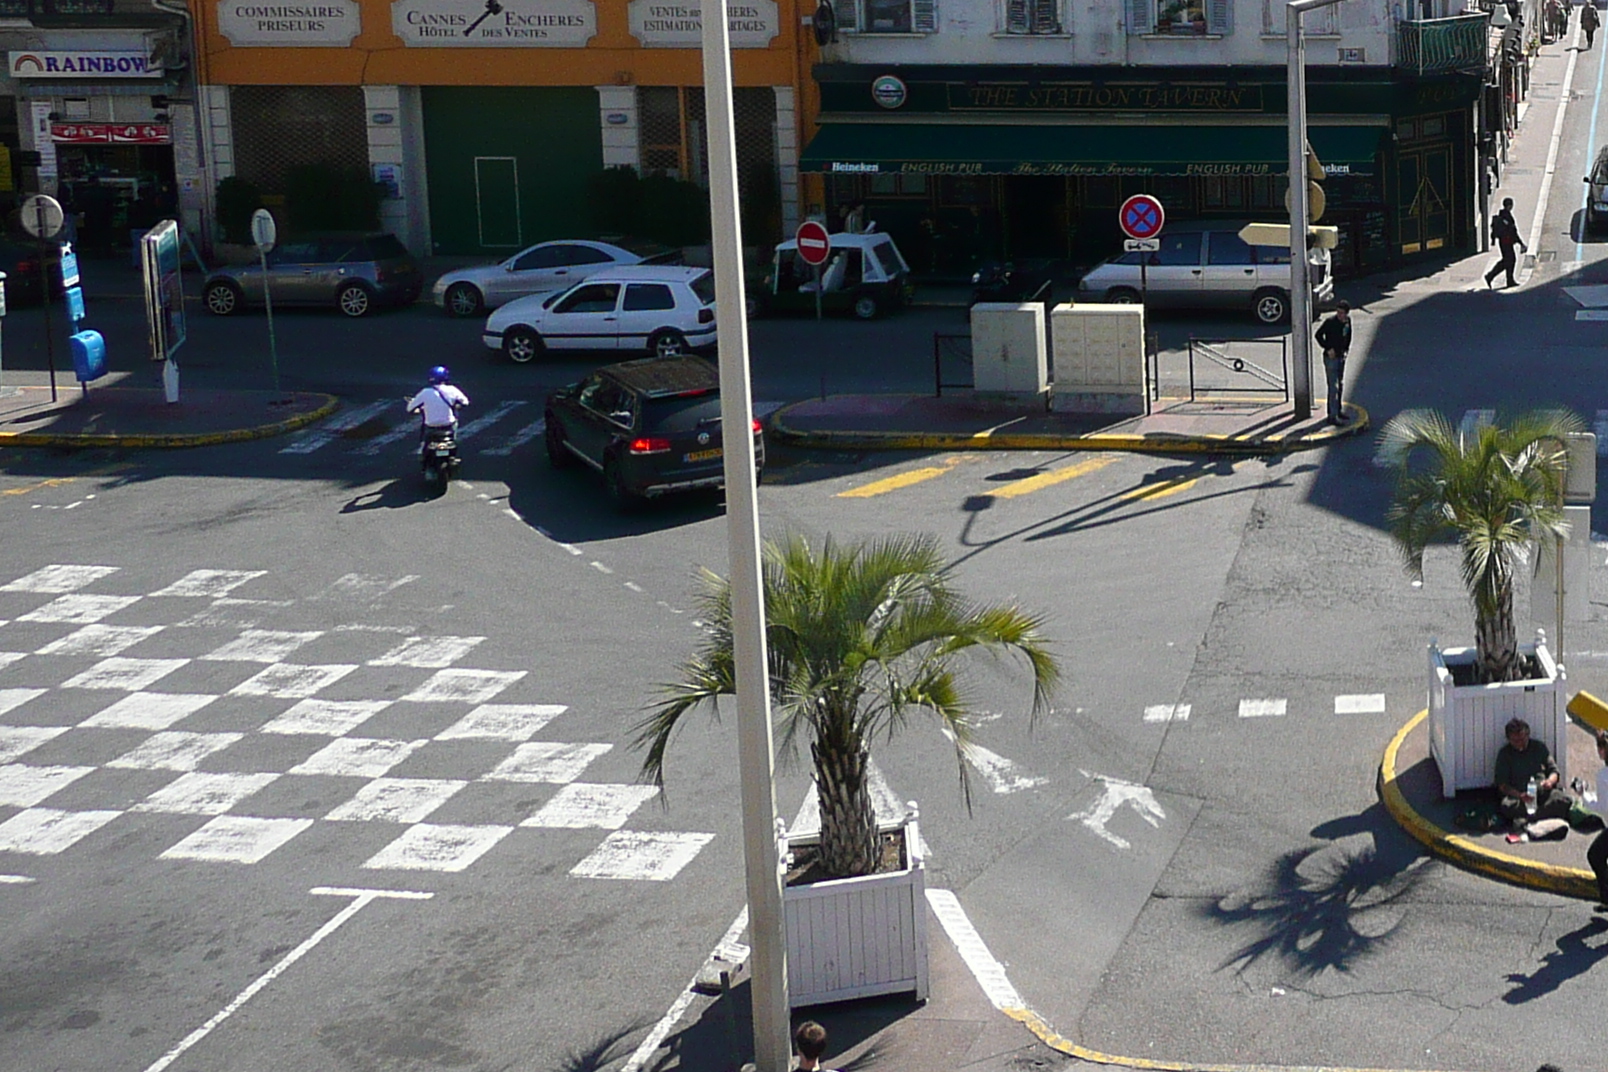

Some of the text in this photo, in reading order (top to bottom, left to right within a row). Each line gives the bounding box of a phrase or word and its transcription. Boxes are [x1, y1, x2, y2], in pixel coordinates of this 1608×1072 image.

[235, 5, 345, 18] COMMISSAIRES
[650, 6, 688, 18] VENTES
[257, 19, 325, 32] PRISEURS
[727, 20, 766, 32] ARTAGES
[45, 56, 149, 73] RAINBOW
[967, 86, 1247, 109] THE STATION TAVERN
[832, 160, 879, 173] Heineken
[901, 162, 983, 173] ENGLISH PUB
[1186, 163, 1269, 174] ENGLISH PUB
